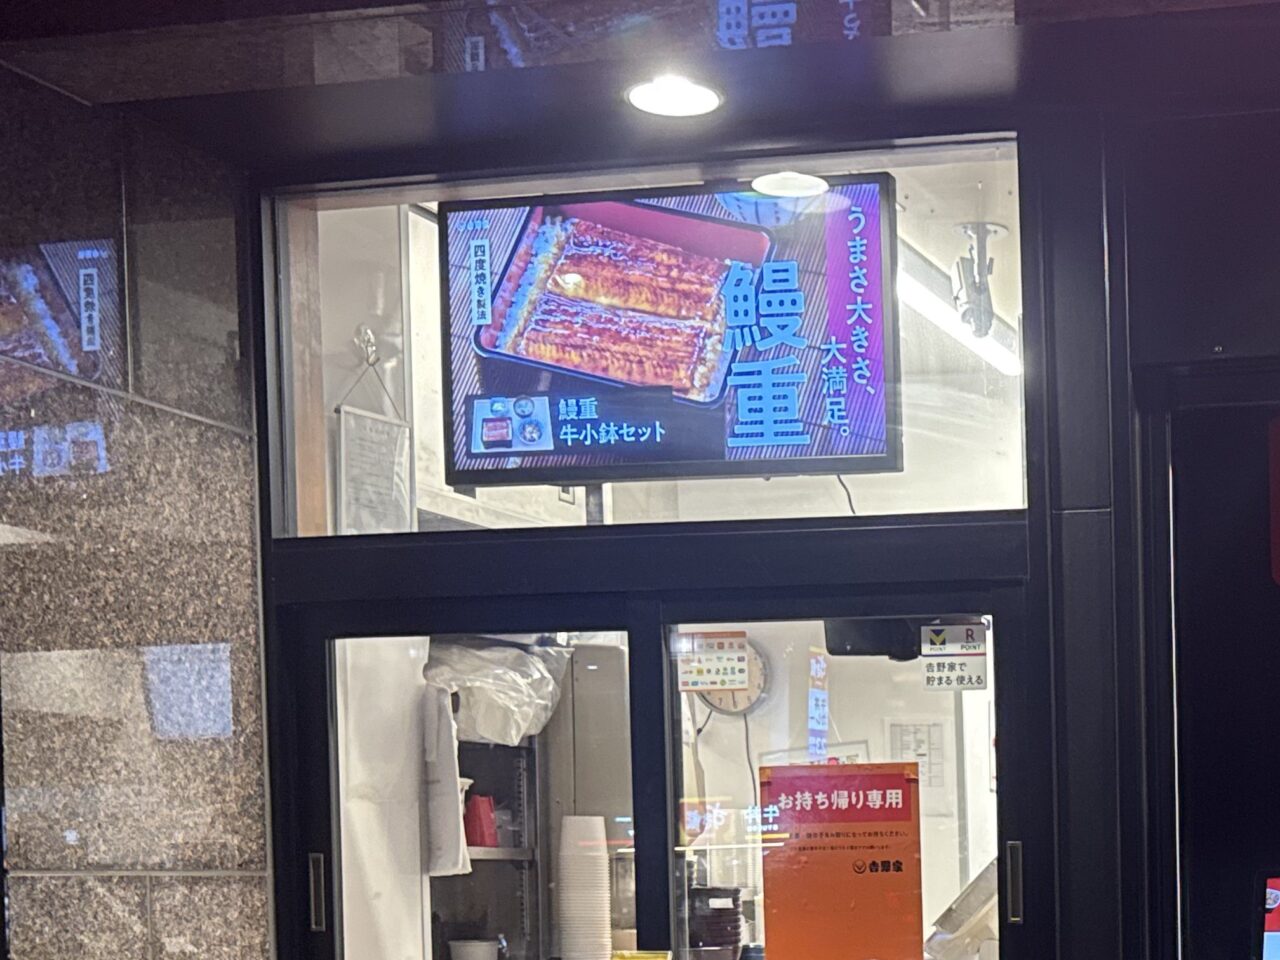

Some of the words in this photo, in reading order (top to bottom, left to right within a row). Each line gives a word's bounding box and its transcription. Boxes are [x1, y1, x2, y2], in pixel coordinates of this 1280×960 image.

[845, 207, 876, 395] うまさ大きさ、
[722, 260, 811, 448] 鰻重
[821, 337, 849, 438] 大満足。
[558, 399, 598, 421] 鰻重
[559, 422, 665, 446] 牛小鉢セット
[926, 675, 953, 686] 貯まる
[956, 675, 983, 685] 使える
[778, 789, 903, 811] お持ち帰り専用
